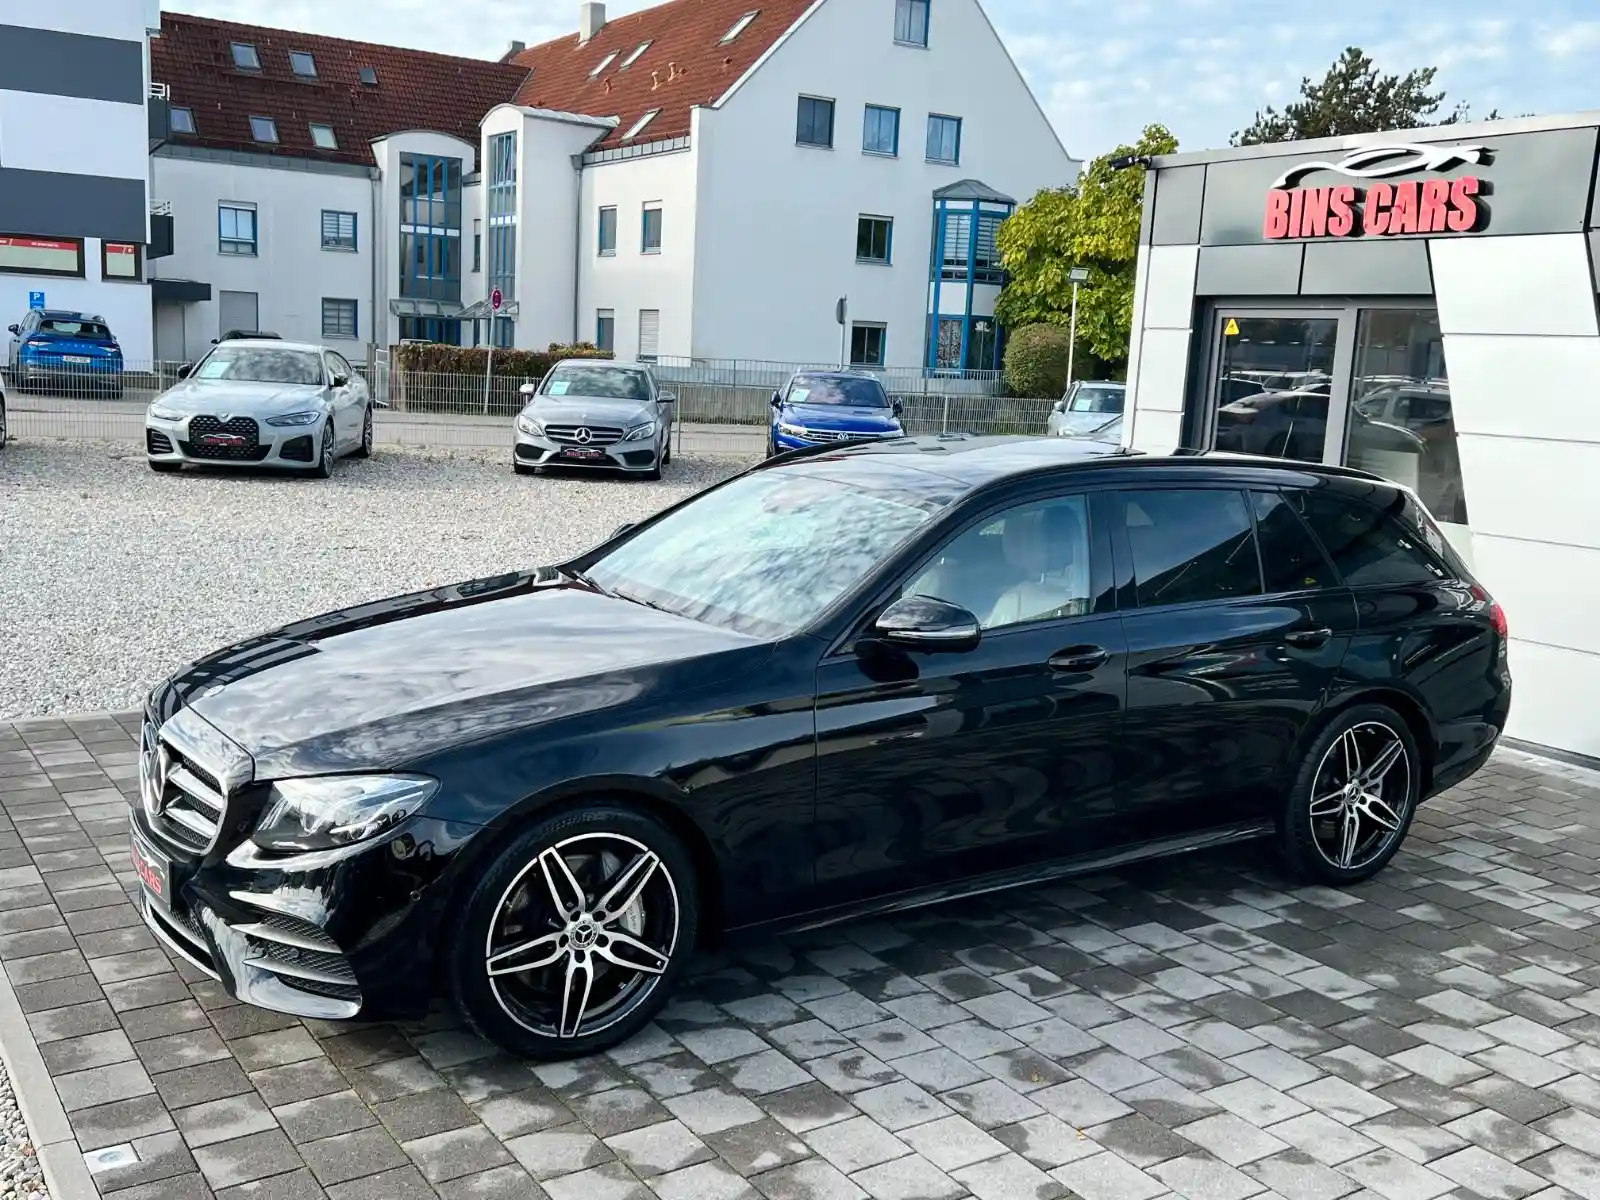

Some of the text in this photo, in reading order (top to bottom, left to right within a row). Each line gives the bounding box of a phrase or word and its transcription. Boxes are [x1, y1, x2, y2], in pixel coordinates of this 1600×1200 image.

[1264, 176, 1480, 239] BINS CARS
[33, 292, 41, 300] P
